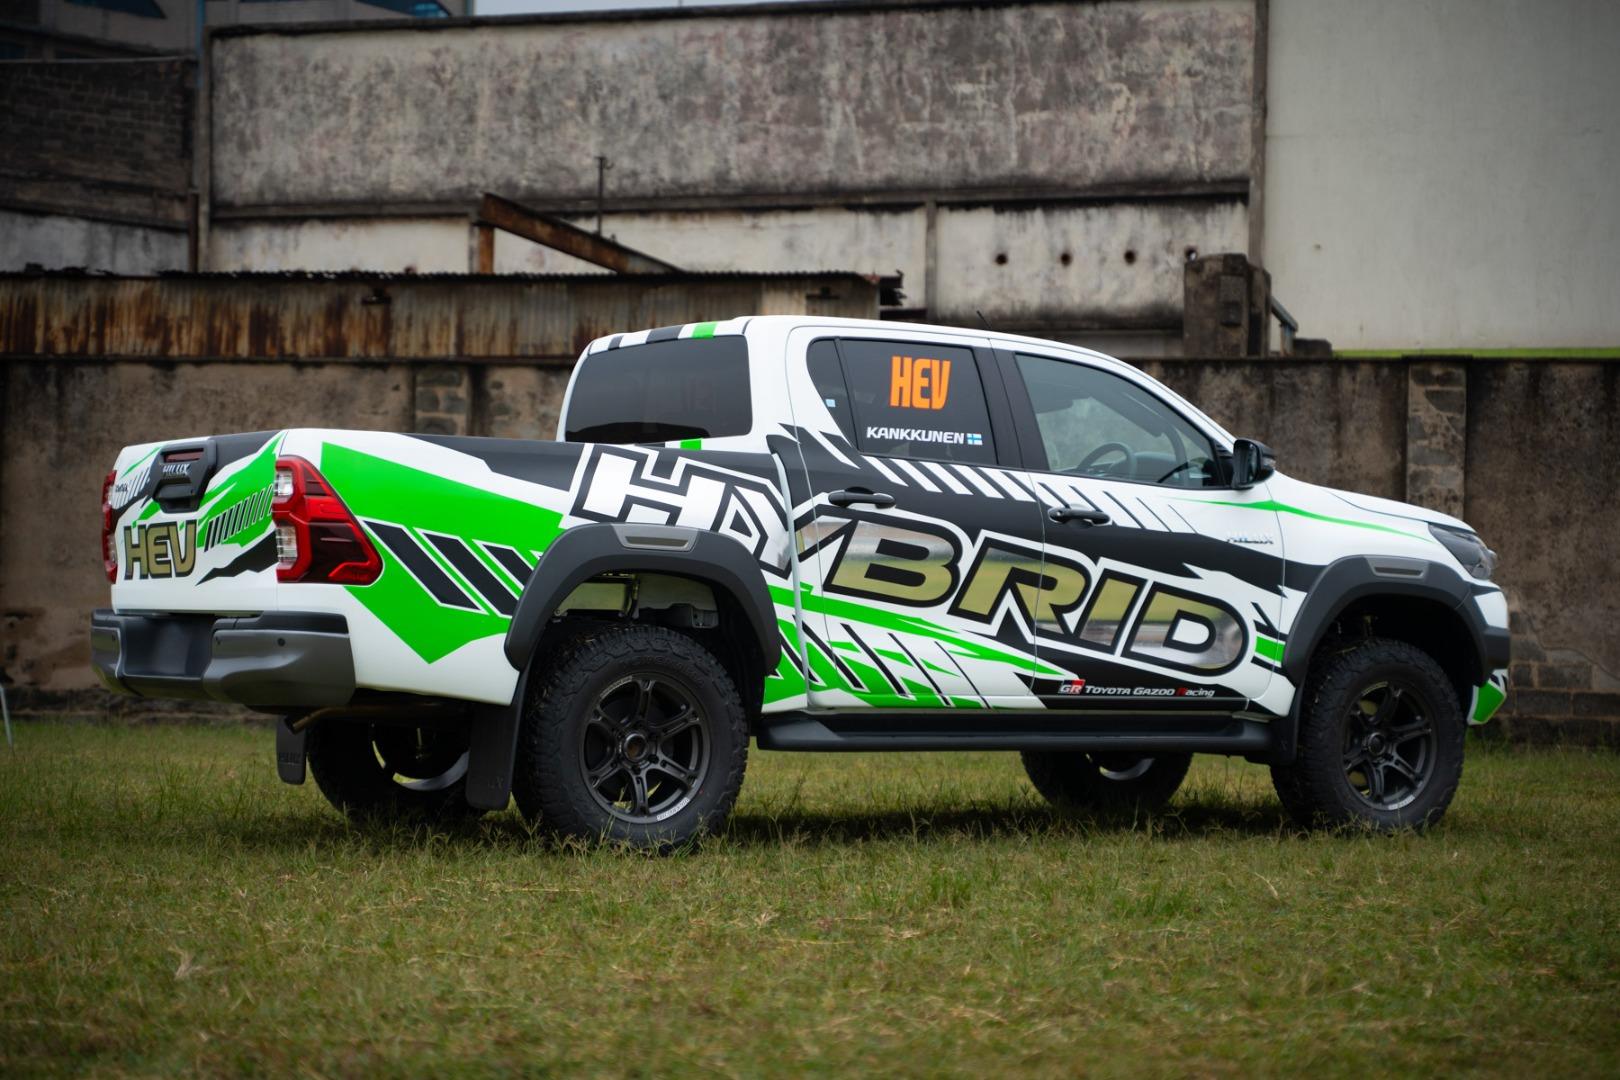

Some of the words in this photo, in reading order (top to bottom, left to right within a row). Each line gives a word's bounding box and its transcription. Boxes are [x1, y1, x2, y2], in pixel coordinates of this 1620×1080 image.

[889, 356, 952, 410] HEV
[866, 426, 965, 444] KANKKUNEN
[124, 519, 198, 580] HEV
[1058, 683, 1083, 695] GR
[1084, 685, 1131, 696] TOYOTA
[1132, 686, 1175, 696] GAZOO
[1176, 687, 1215, 698] Racing
